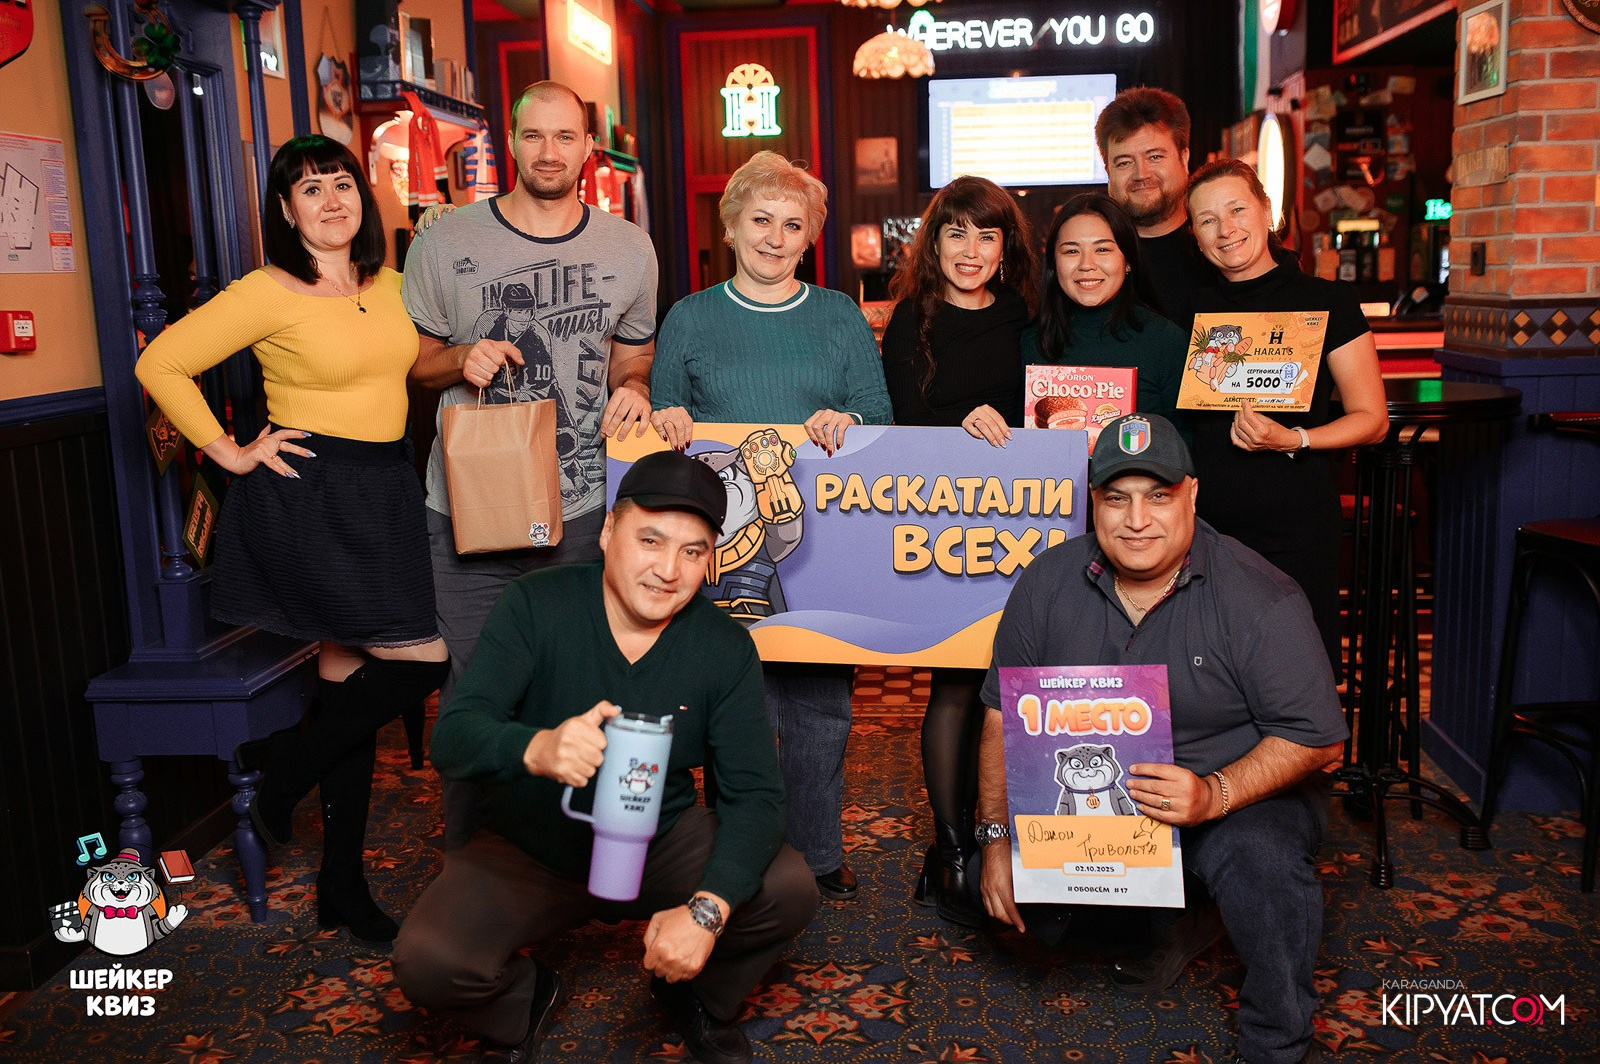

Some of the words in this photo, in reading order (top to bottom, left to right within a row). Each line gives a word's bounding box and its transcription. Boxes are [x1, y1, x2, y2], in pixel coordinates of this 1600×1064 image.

[1050, 15, 1106, 46] YOU
[1115, 12, 1155, 44] GO
[481, 281, 502, 311] IN
[535, 363, 550, 381] 10
[1066, 374, 1095, 382] ORION
[1246, 376, 1281, 389] 5000
[816, 473, 1074, 518] РАСКАТАЛИ
[1039, 677, 1087, 689] ШЕЙКЕР
[1090, 677, 1124, 689] КВИЗ
[1018, 694, 1042, 736] 1
[1045, 696, 1153, 736] МЕСТО
[1075, 865, 1115, 873] 02.10.2025
[1114, 886, 1128, 894] #17
